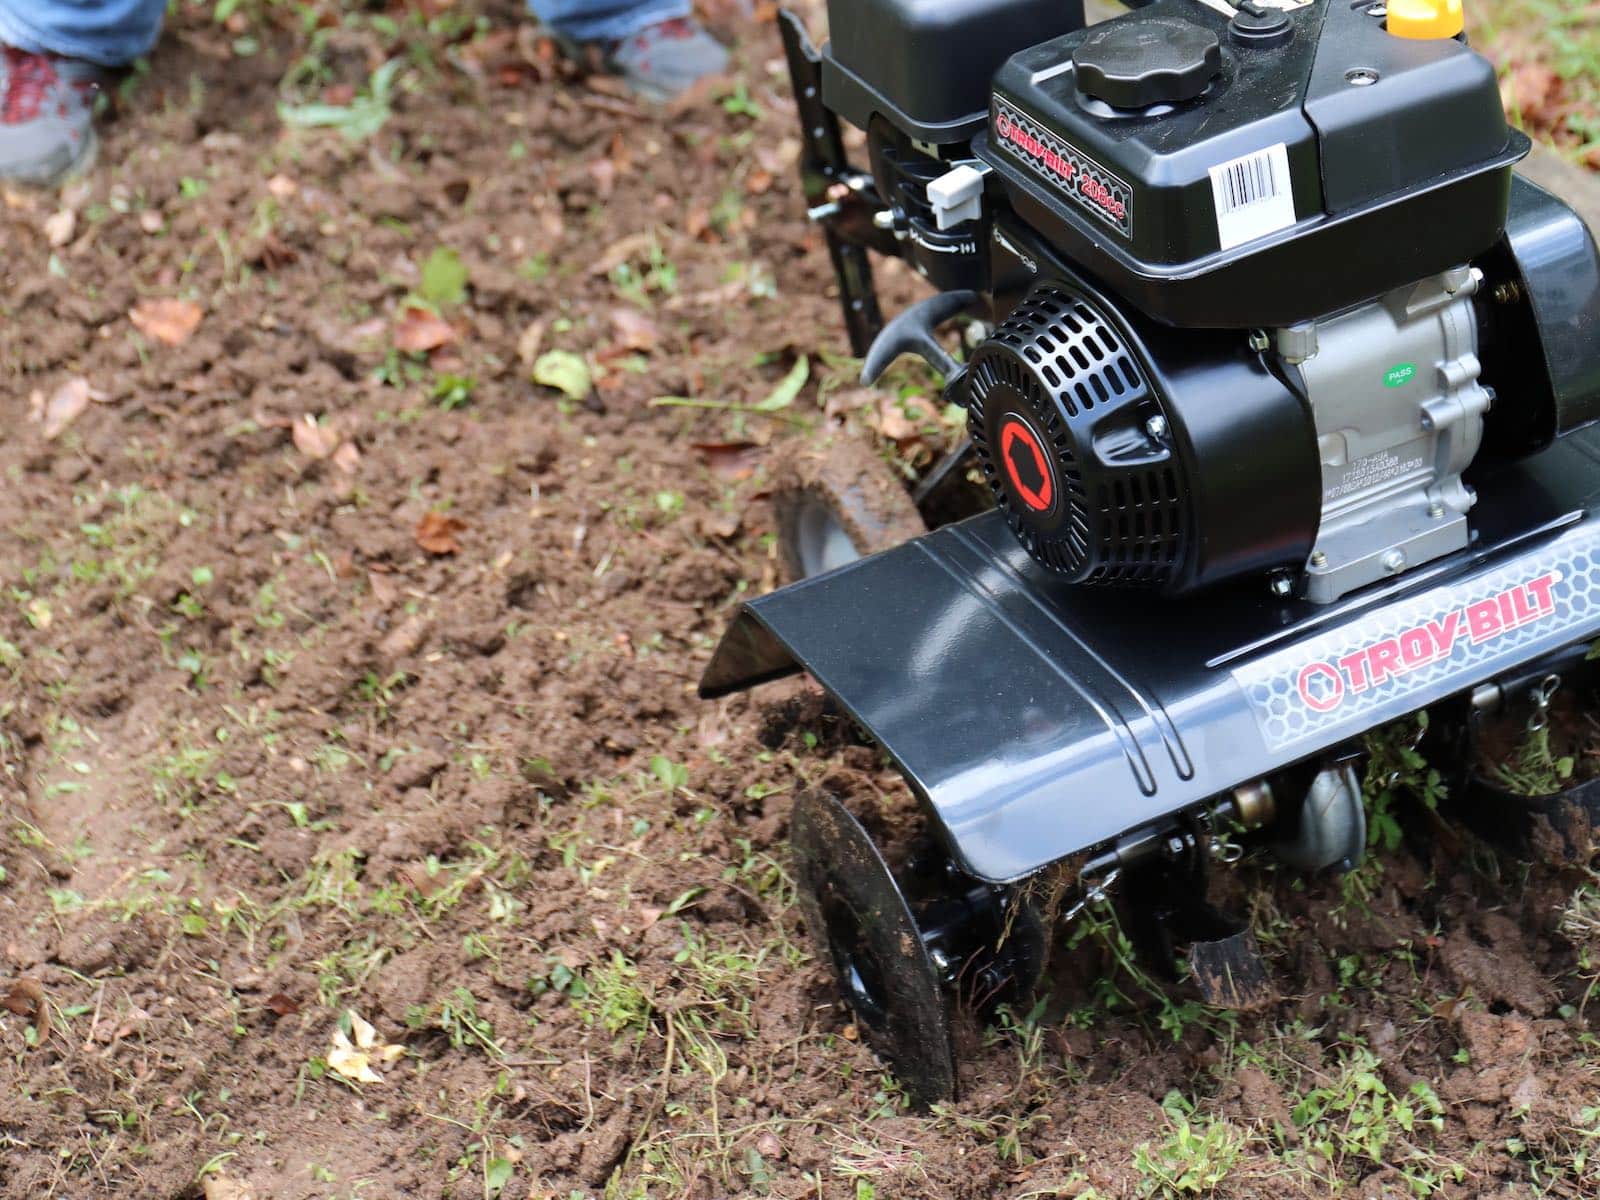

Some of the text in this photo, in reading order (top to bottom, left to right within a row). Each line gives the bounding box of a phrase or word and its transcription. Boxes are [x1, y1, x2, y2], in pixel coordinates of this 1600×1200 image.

[1009, 123, 1073, 181] TROY-BILT
[1081, 173, 1124, 219] 208cc
[1388, 367, 1412, 381] PASS
[1338, 574, 1556, 694] TROY-BILT
